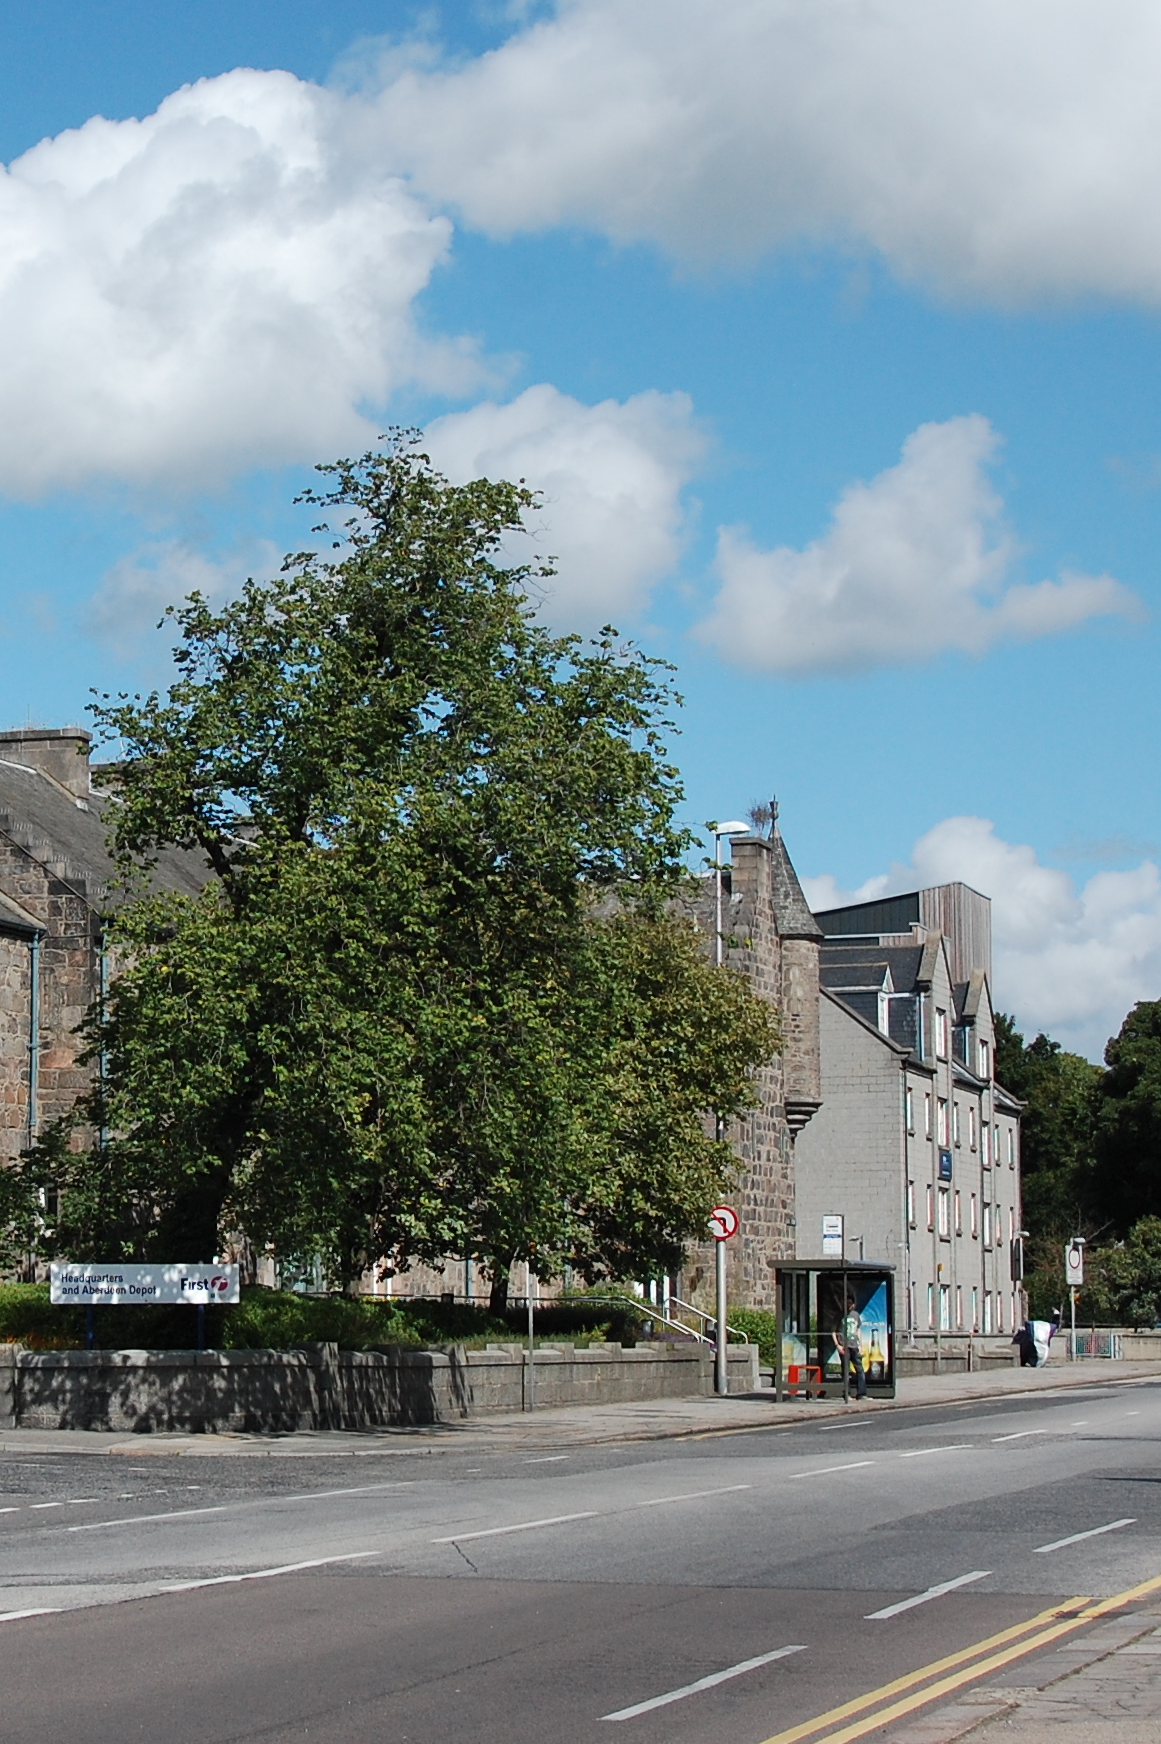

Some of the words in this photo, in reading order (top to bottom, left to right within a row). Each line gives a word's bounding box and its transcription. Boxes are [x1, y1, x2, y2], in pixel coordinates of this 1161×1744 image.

[61, 1274, 123, 1284] Headquarters
[180, 1278, 209, 1291] First
[62, 1286, 79, 1294] and
[82, 1285, 126, 1294] Aberdeen
[129, 1285, 156, 1297] Depot
